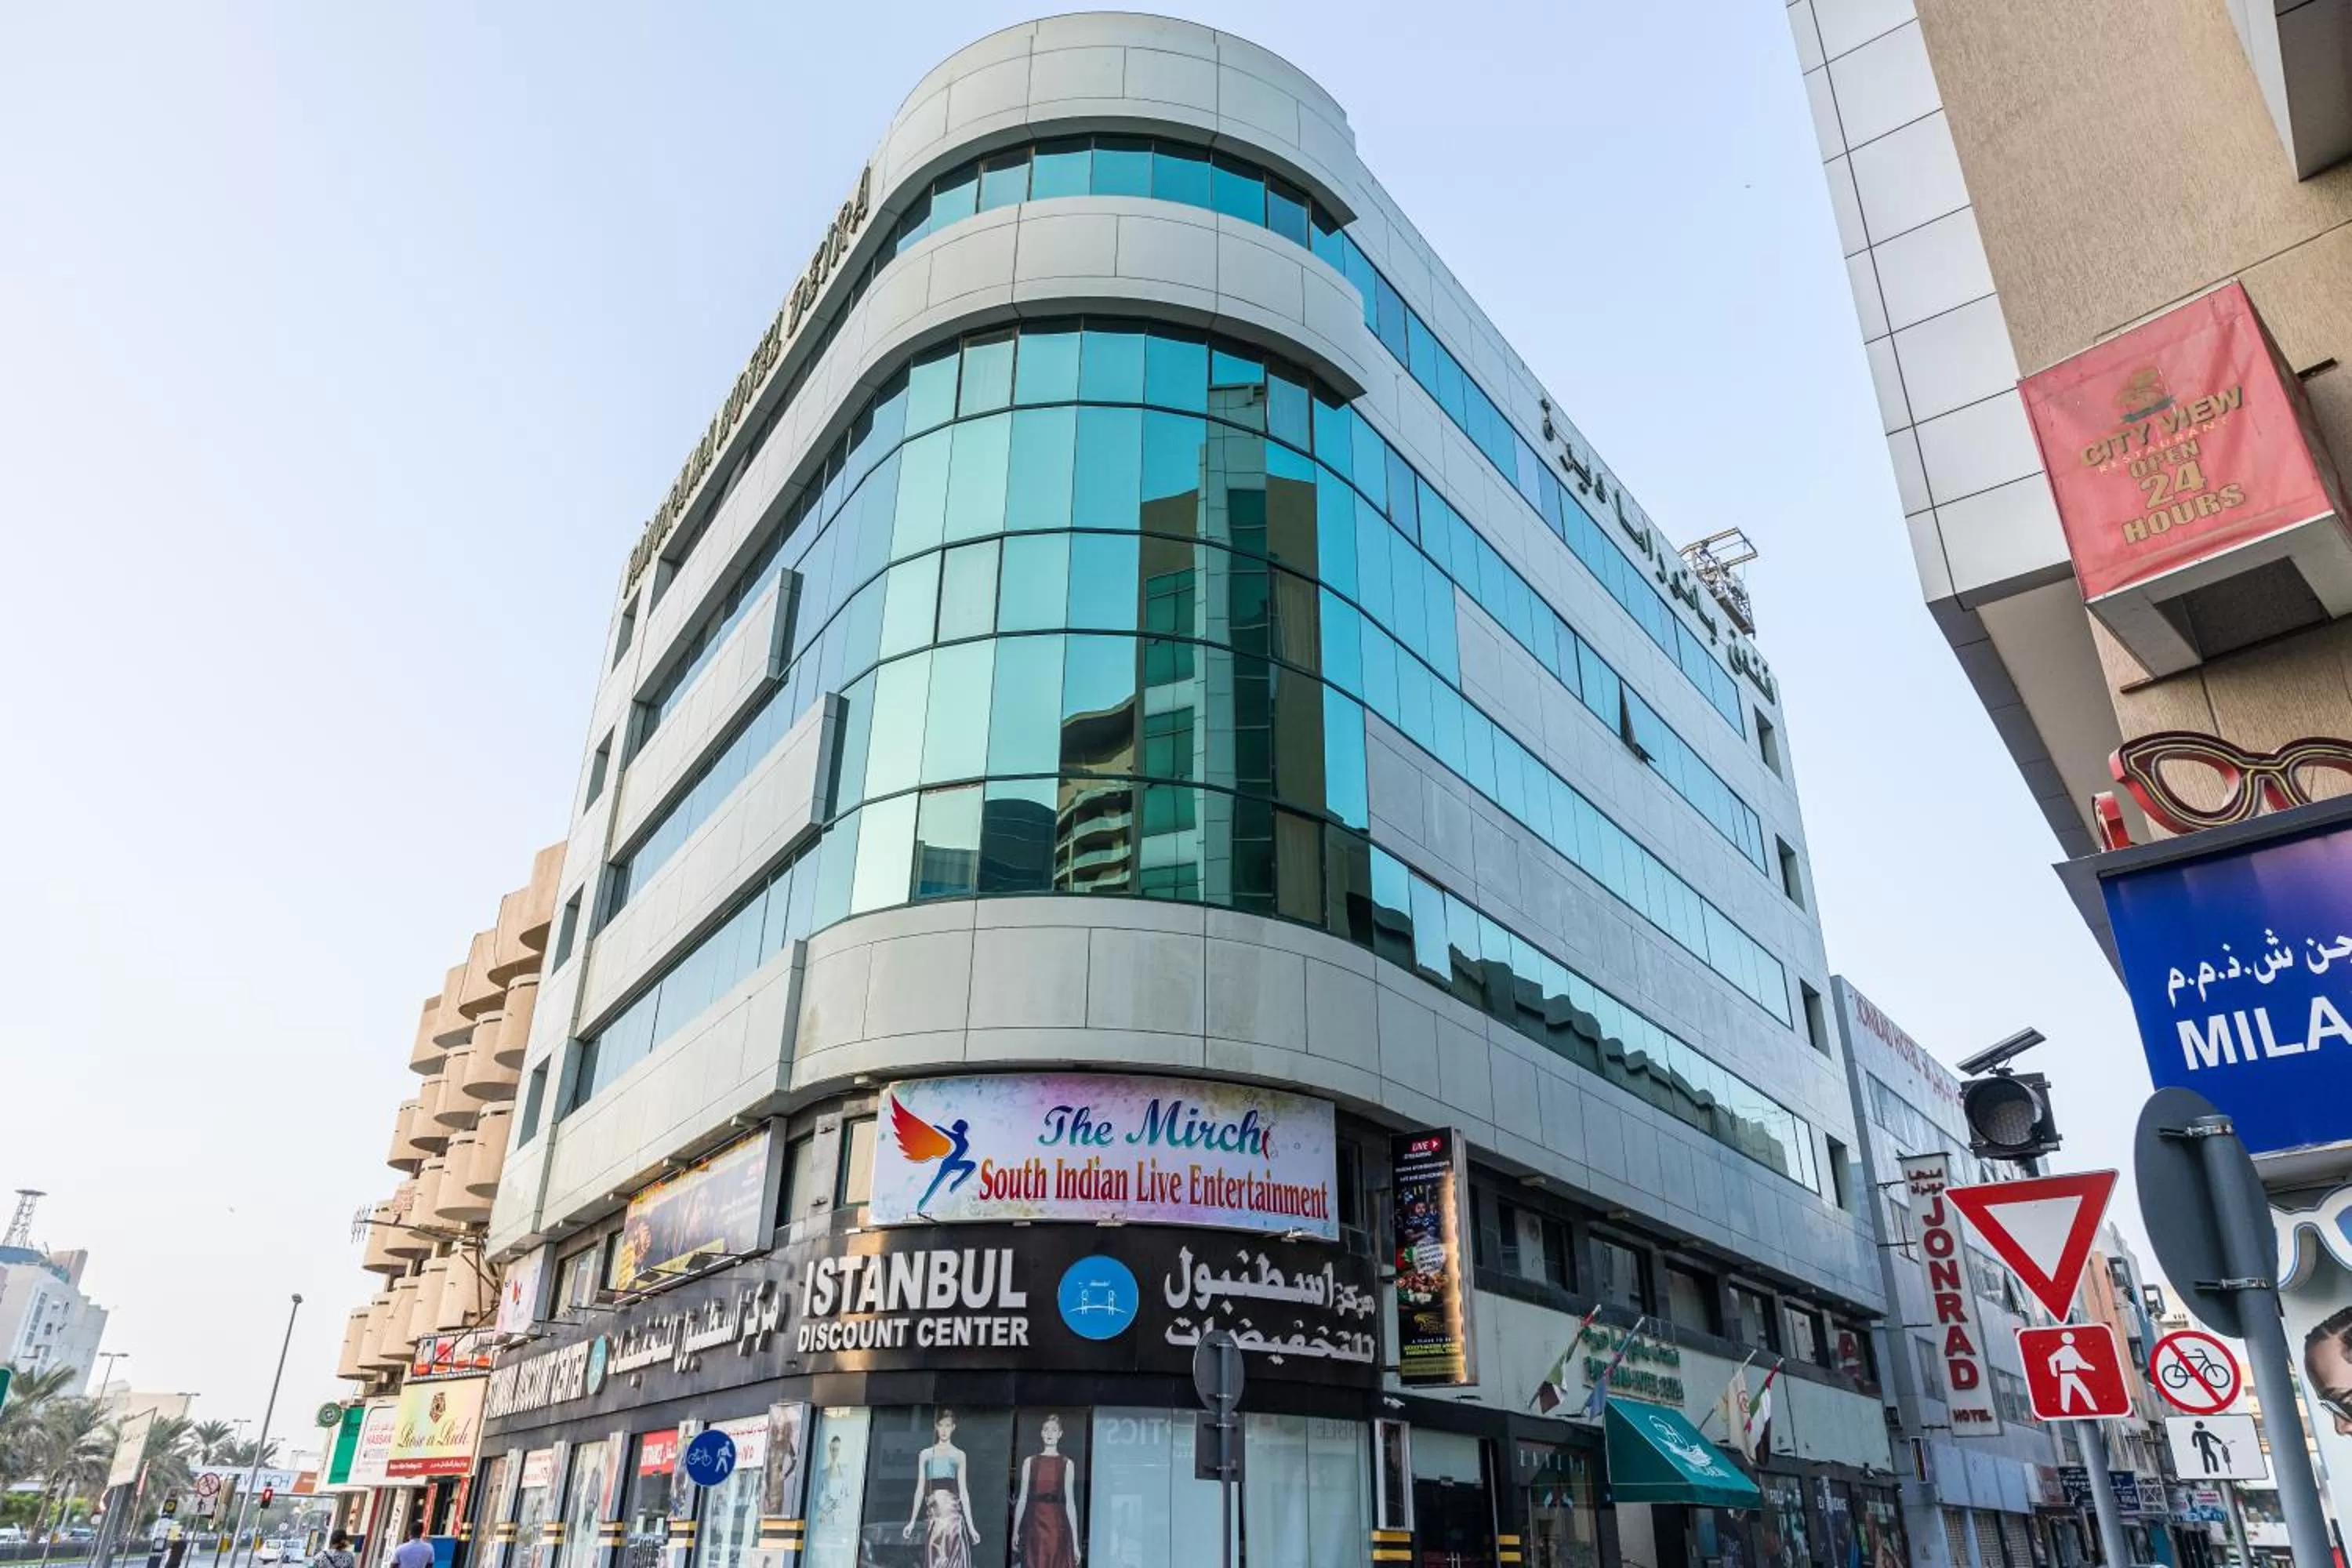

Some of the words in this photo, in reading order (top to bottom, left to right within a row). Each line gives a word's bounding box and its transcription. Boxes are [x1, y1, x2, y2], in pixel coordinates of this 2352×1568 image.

[787, 163, 871, 339] DEIRA
[2081, 423, 2151, 466] CITY
[2158, 384, 2242, 434] VIEW
[2098, 417, 2227, 474] RESTAURANT
[2129, 438, 2201, 478] OPEN
[2139, 459, 2209, 510] 24
[2122, 483, 2246, 545] HOURS
[2176, 995, 2352, 1071] MILA
[1038, 1105, 1114, 1147] The
[1411, 1140, 1429, 1152] LIVE
[979, 1156, 1047, 1201] South
[1054, 1155, 1129, 1201] Indian
[1136, 1158, 1181, 1204] Live
[1189, 1164, 1330, 1221] Entertainment
[802, 1248, 1027, 1317] ISTANBUL
[1163, 1246, 1334, 1315] اسطنبول
[1333, 1283, 1376, 1320] مركز
[1922, 1196, 1980, 1390] JONRAD
[797, 1318, 910, 1353] DISCOUNT
[916, 1316, 1029, 1348] CENTER
[1952, 1409, 1992, 1423] HOTEL
